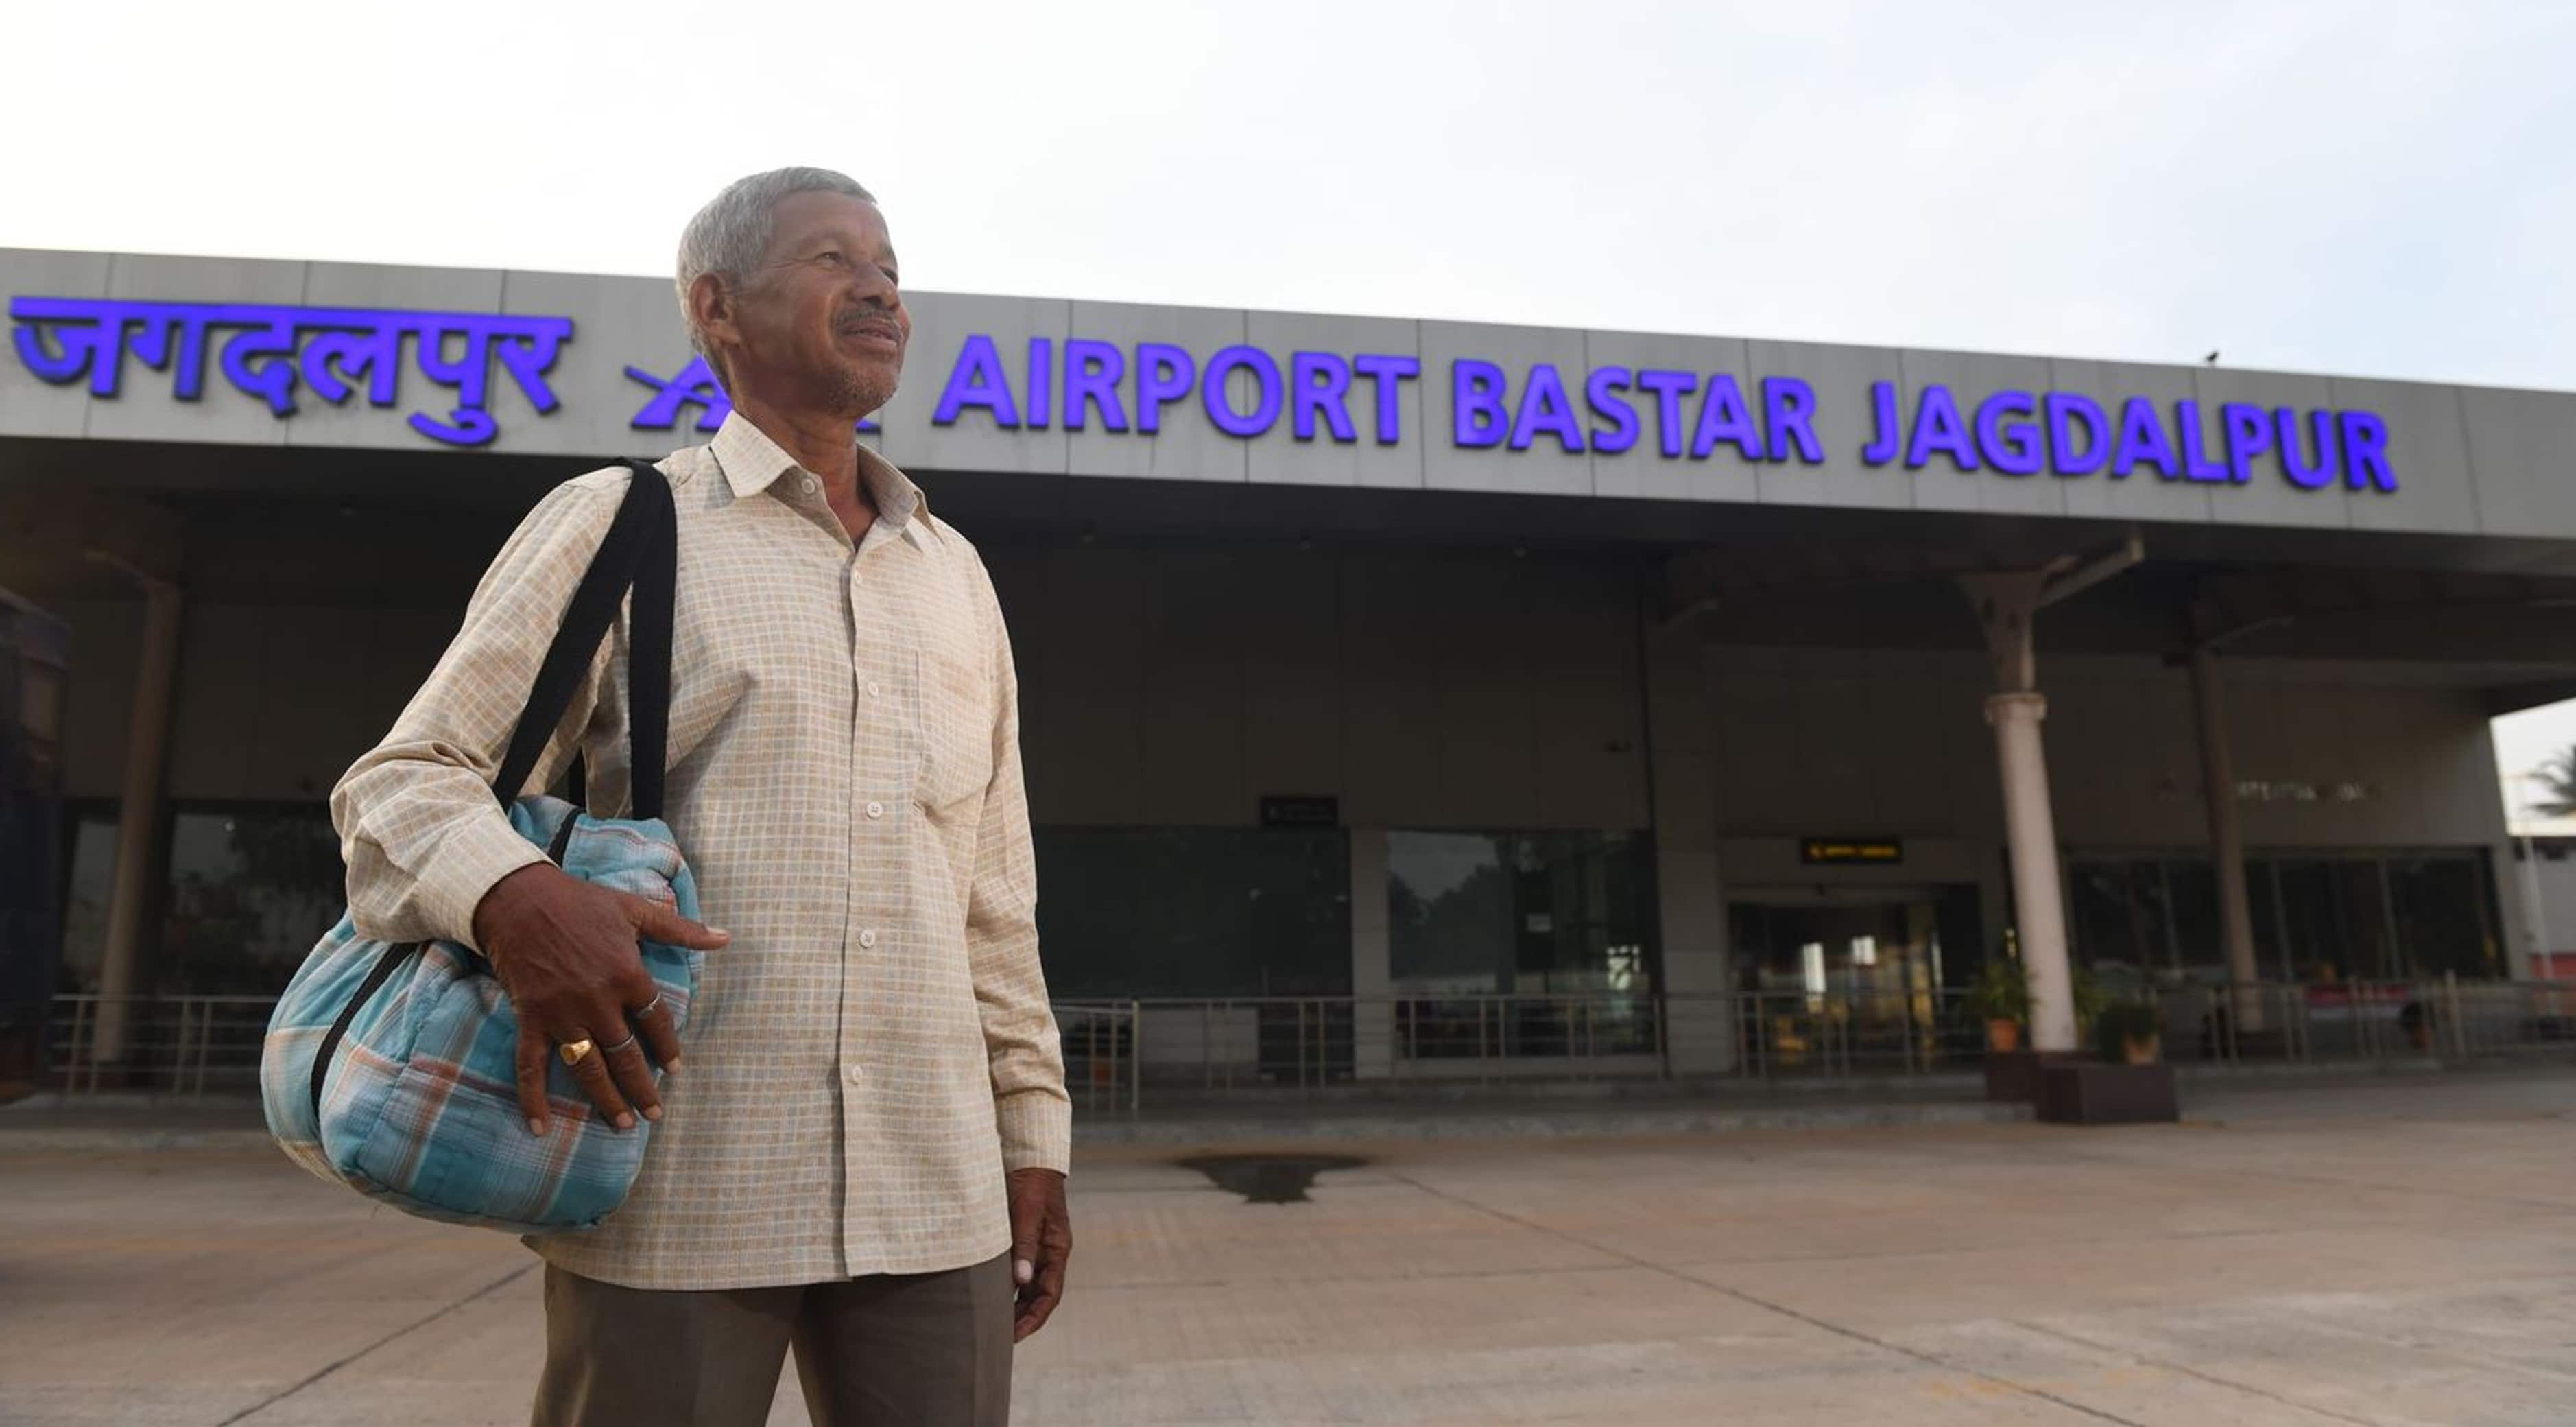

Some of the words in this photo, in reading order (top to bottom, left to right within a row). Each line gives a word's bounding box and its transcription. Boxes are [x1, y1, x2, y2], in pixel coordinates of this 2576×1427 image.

[10, 296, 573, 445] जगदलपुर
[933, 334, 1420, 444] AIRPORT
[1453, 359, 1825, 464] BASTAR
[1862, 381, 2398, 491] JAGDALPUR
